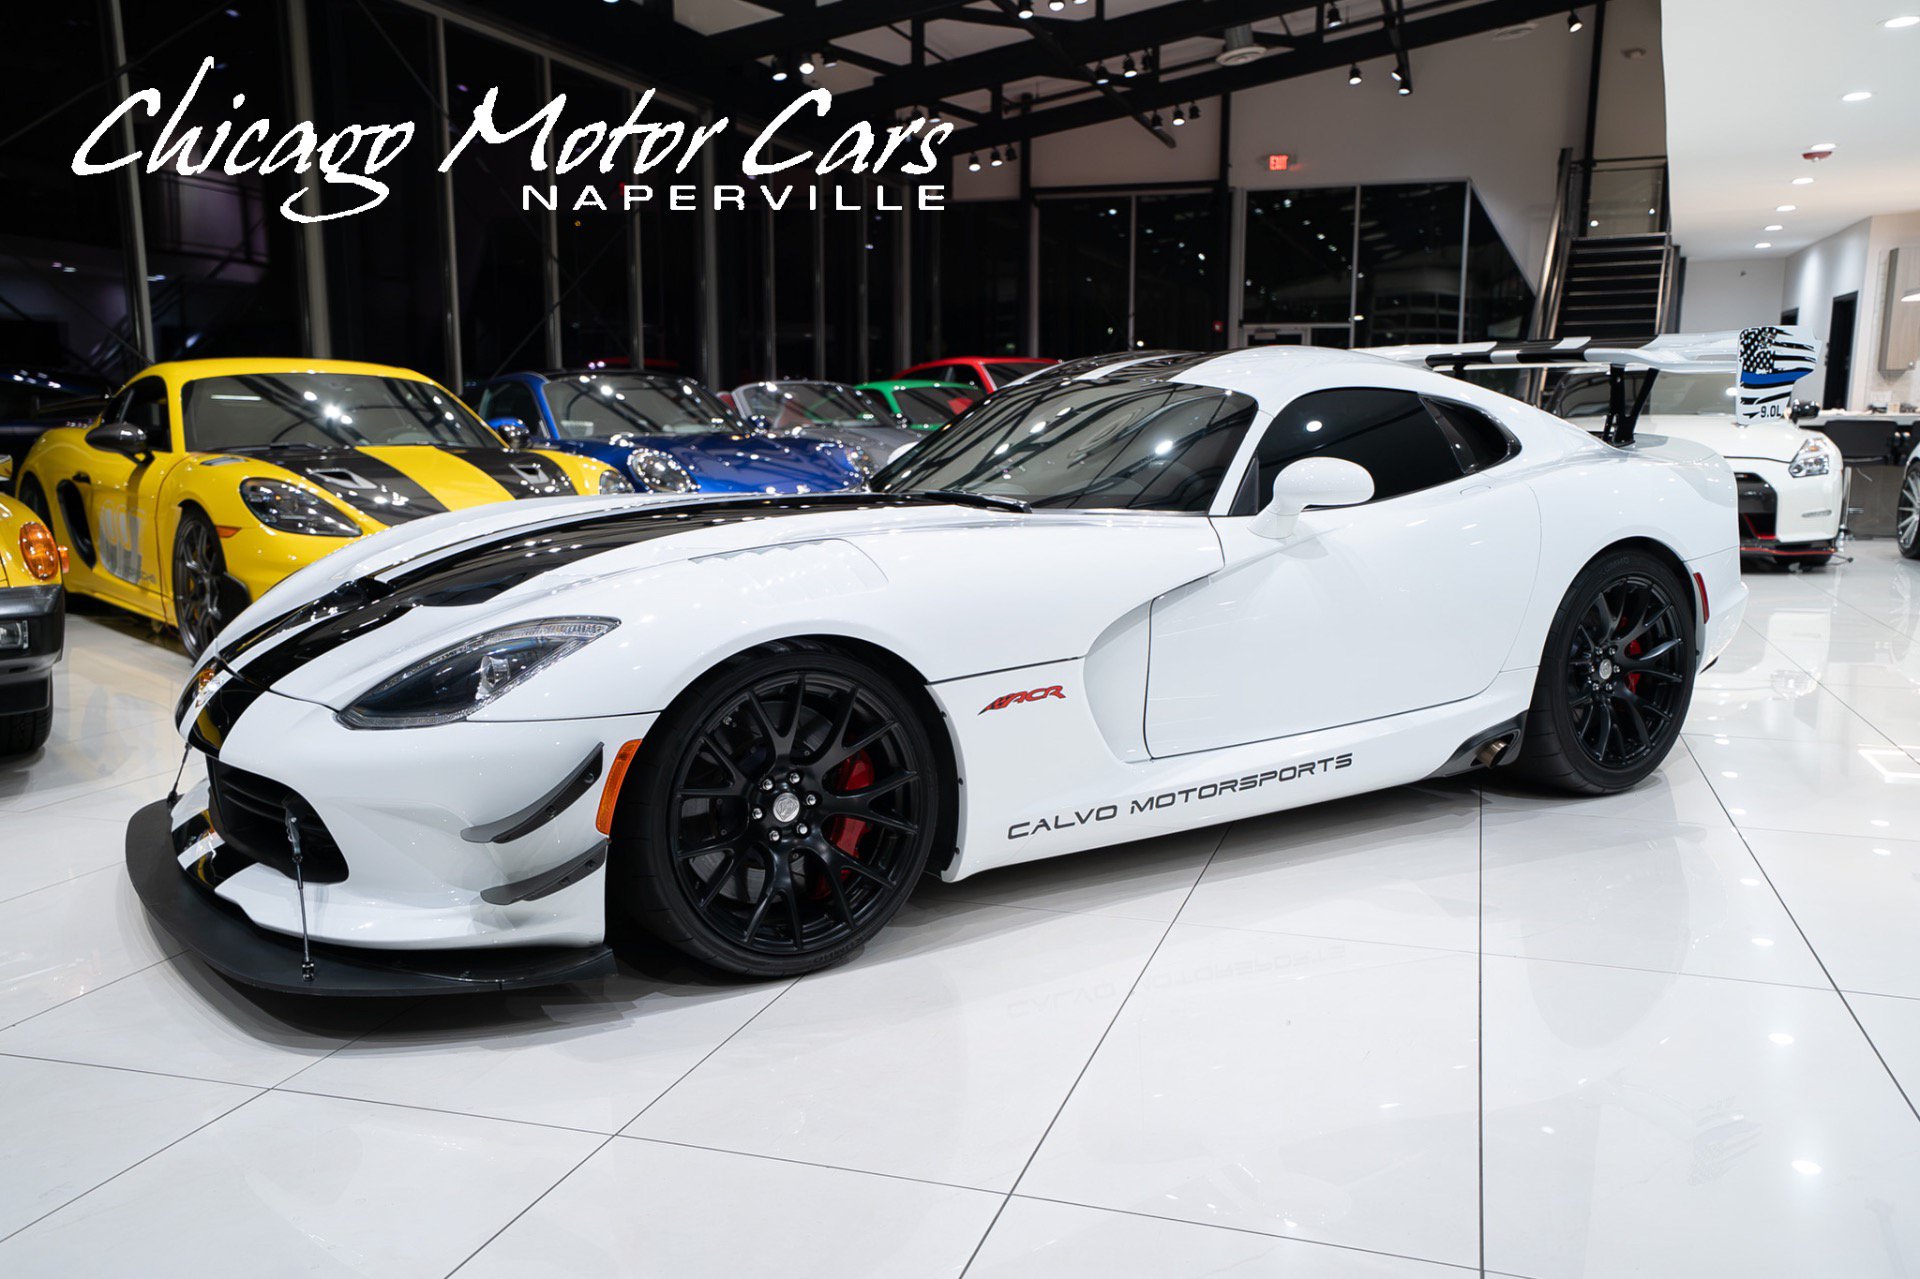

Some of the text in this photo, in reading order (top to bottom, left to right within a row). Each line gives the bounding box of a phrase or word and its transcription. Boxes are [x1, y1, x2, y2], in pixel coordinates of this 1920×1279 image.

[1269, 154, 1289, 171] EXIT
[1760, 405, 1783, 419] 9.0L
[988, 685, 1067, 710] ACR
[1007, 752, 1353, 840] CALVO MOTORSPORTS
